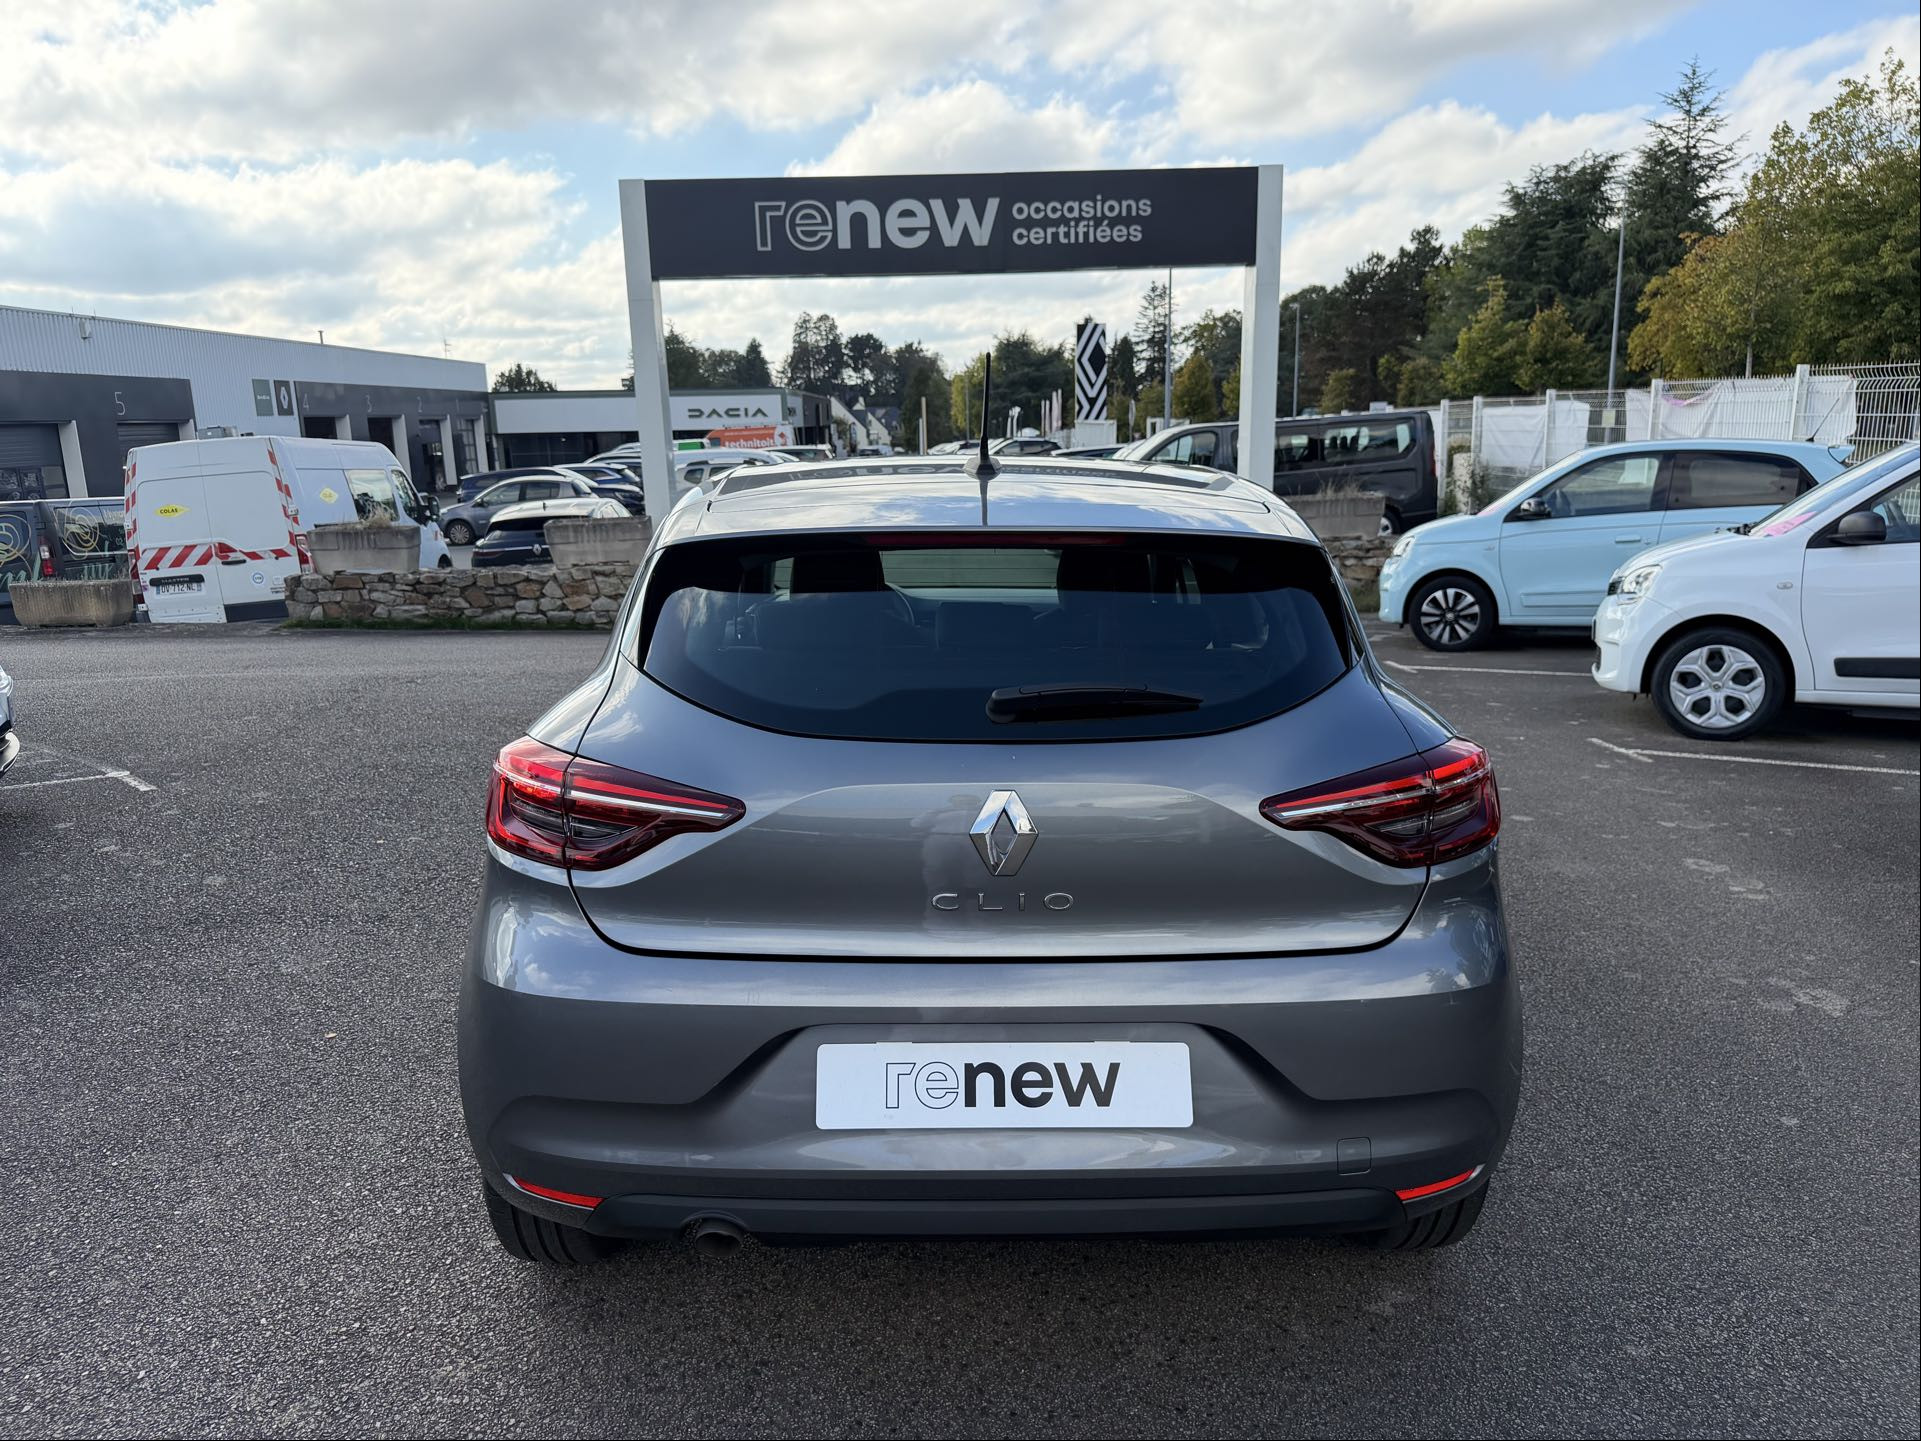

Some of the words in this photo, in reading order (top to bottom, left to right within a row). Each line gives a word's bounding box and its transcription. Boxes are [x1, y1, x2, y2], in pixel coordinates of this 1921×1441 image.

[1011, 194, 1152, 219] occasions
[754, 196, 1000, 252] renew
[1011, 220, 1143, 246] certifiées
[114, 391, 126, 415] 5
[303, 393, 310, 410] 4
[364, 394, 373, 413] 3
[687, 407, 769, 419] DACIA
[931, 892, 1074, 911] CLIO
[885, 1060, 1121, 1110] renew
